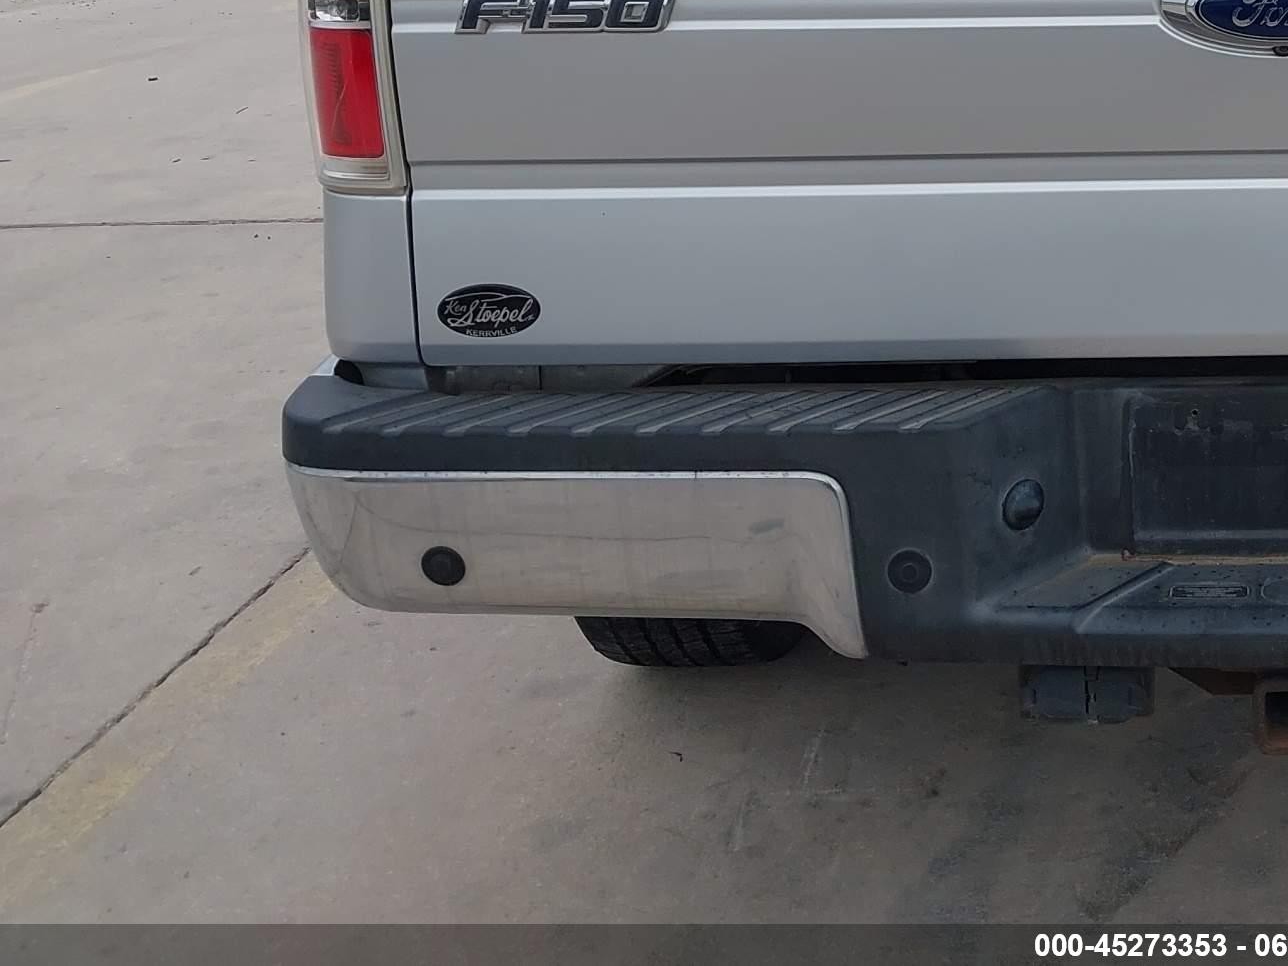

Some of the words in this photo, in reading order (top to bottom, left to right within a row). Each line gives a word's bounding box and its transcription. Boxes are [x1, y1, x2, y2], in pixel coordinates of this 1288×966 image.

[444, 299, 467, 315] Ken
[447, 296, 535, 327] Stoepel
[466, 327, 517, 337] KERRVILLE
